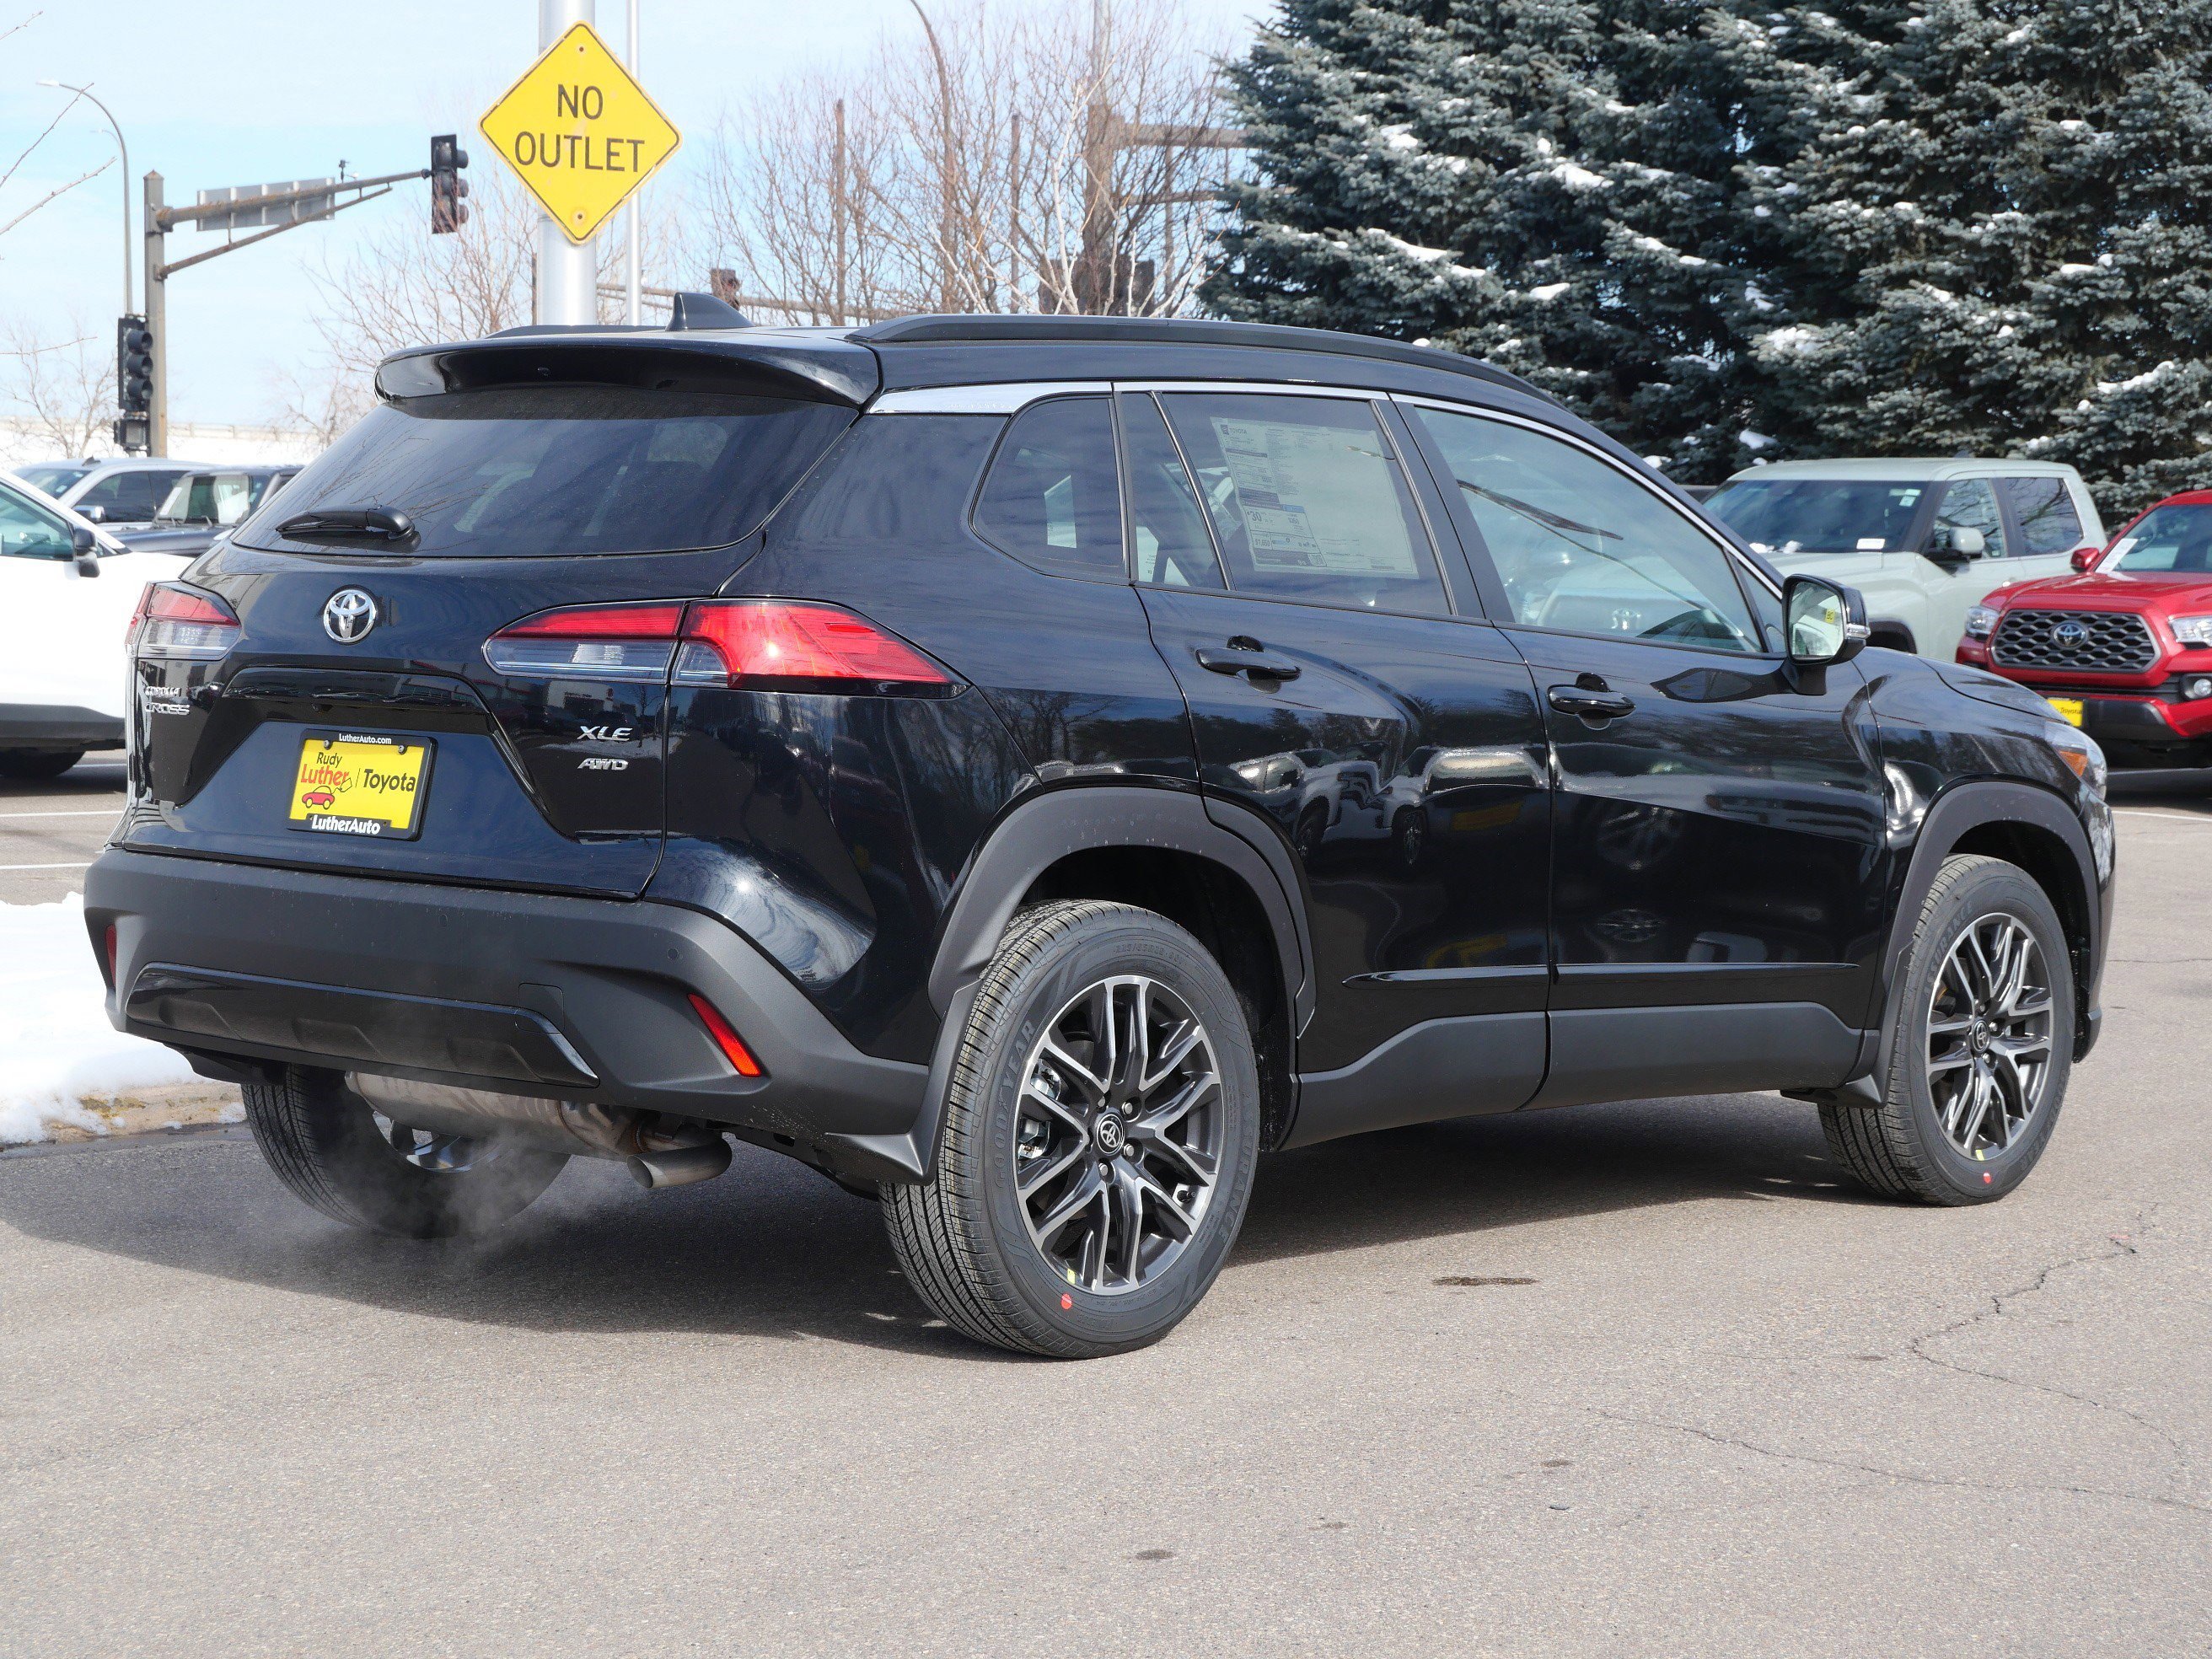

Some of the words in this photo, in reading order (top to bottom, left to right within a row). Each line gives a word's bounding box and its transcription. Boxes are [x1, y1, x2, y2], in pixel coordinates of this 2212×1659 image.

[557, 83, 604, 120] NO
[514, 131, 645, 173] OUTLET
[145, 701, 191, 715] CROSS
[339, 733, 392, 744] LutherAuto.com
[577, 726, 633, 742] XLE
[316, 751, 342, 768] Rudy
[577, 758, 629, 770] AWD
[300, 764, 350, 786] Luther
[363, 769, 416, 793] Toyota
[311, 814, 381, 835] LutherAuto
[994, 1019, 1036, 1189] GOODYEAR
